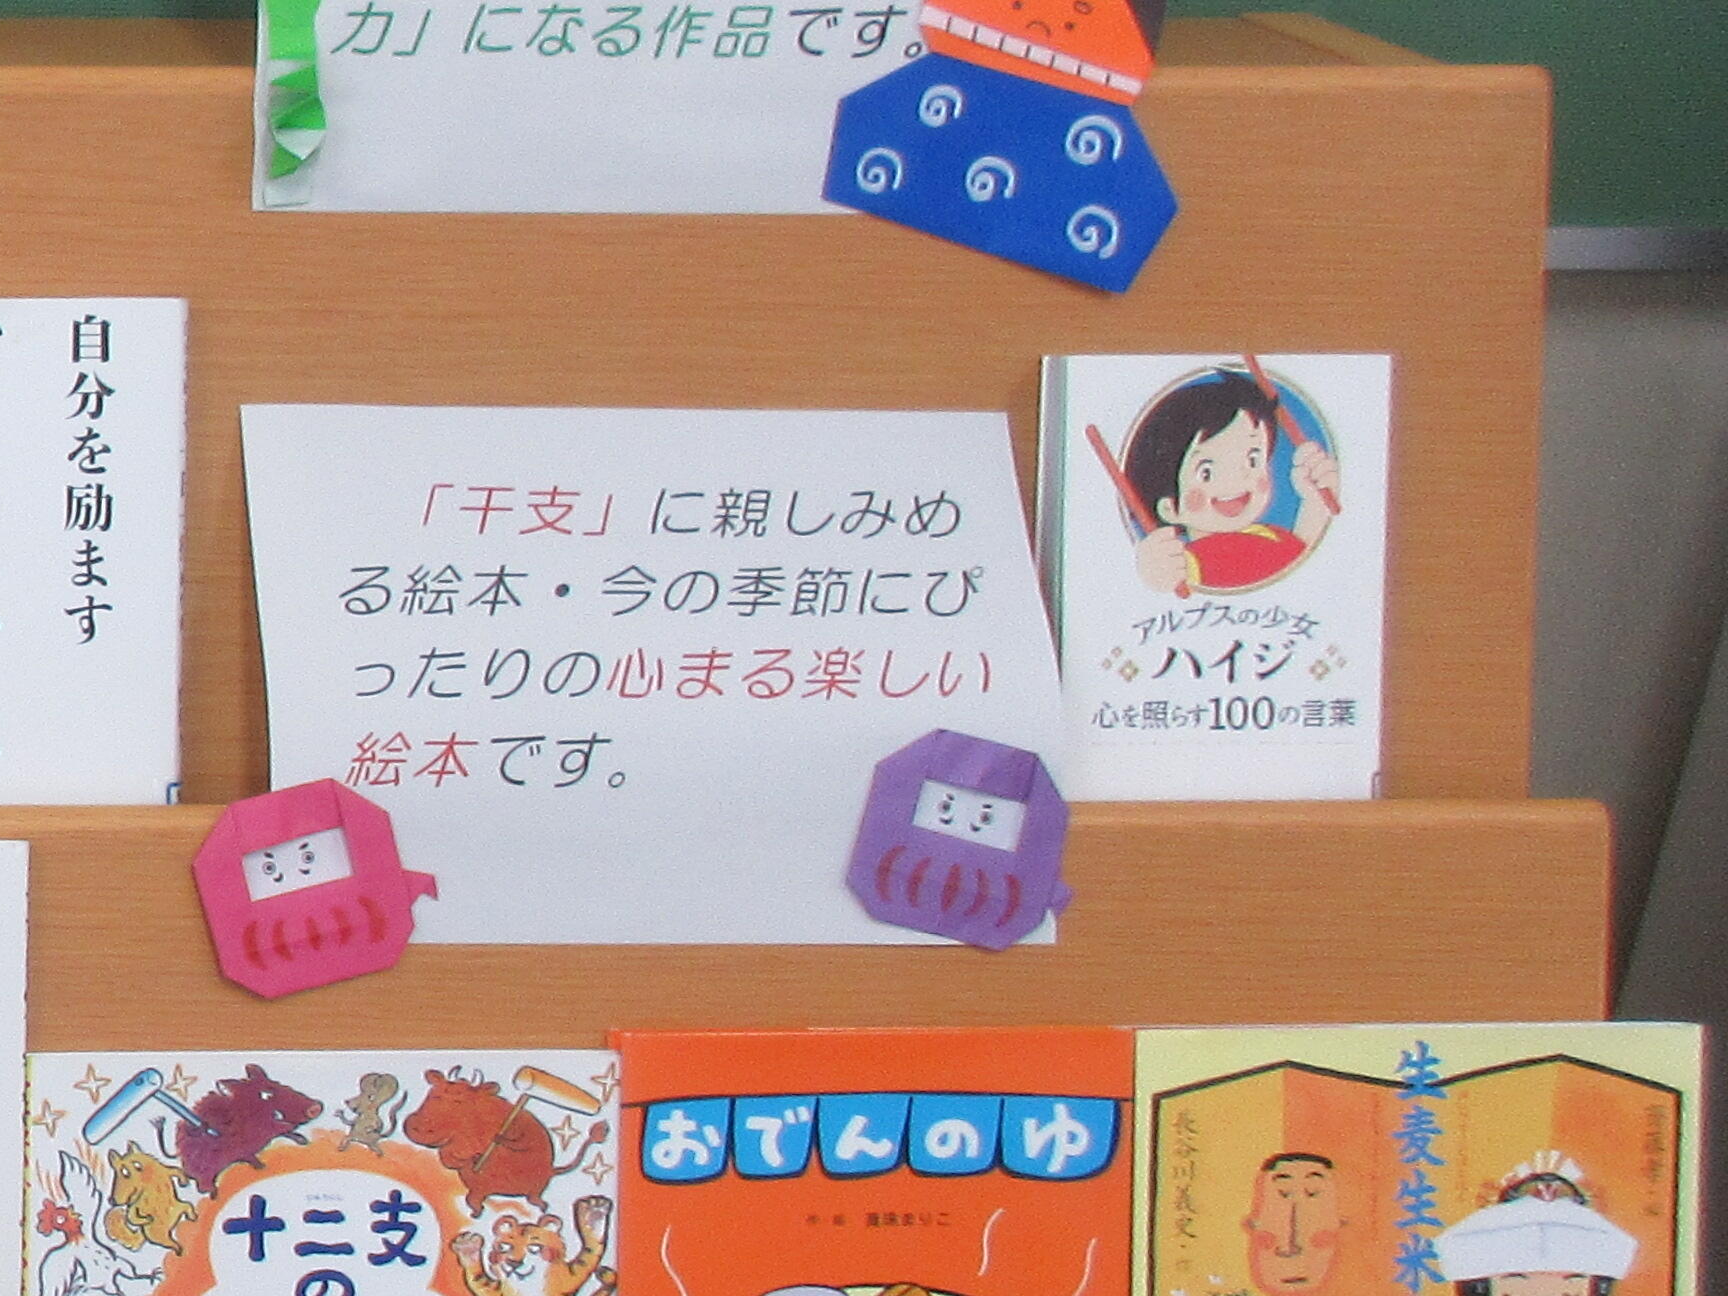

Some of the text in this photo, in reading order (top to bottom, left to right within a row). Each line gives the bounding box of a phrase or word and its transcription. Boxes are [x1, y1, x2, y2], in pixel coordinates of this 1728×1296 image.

[63, 313, 116, 646] 自分を励ます
[420, 482, 963, 542] 「干支」に親しみめ
[336, 563, 986, 619] る絵本・今の季節にぴ
[1132, 601, 1321, 648] アルプスの少女
[350, 644, 993, 701] ったりの心まる楽しい
[1151, 637, 1297, 684] ハイジ
[1091, 695, 1359, 732] 心を照らす100の言葉
[344, 729, 630, 791] 絵本です。
[649, 1101, 1092, 1174] おでんのゆ
[221, 1188, 428, 1267] 十二支
